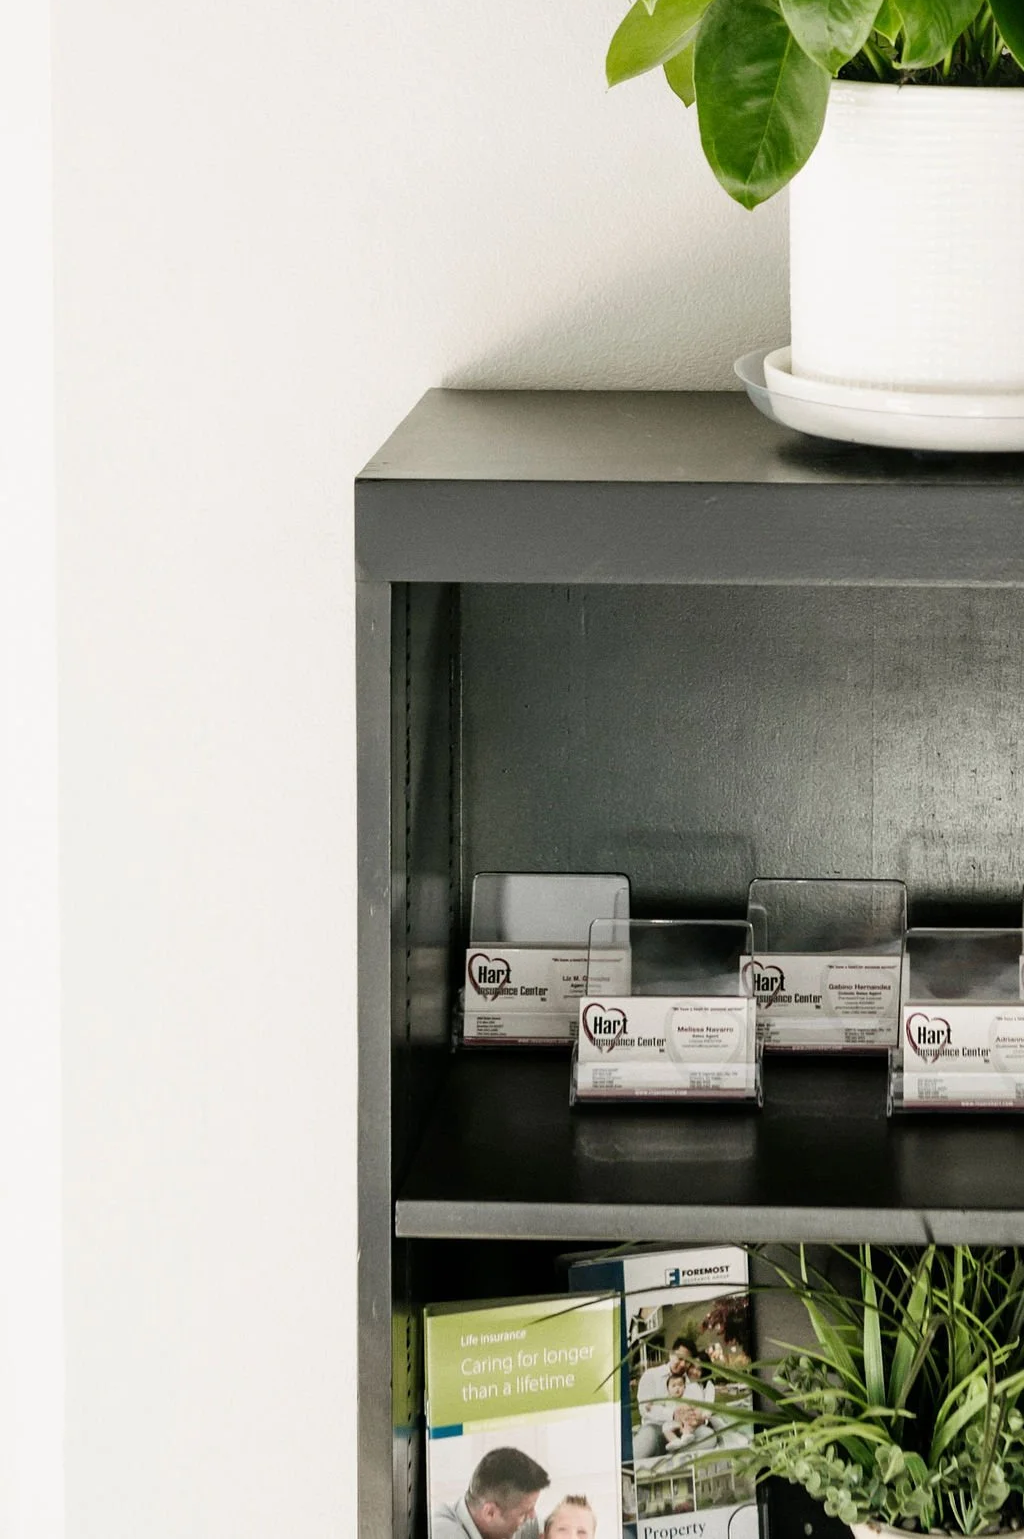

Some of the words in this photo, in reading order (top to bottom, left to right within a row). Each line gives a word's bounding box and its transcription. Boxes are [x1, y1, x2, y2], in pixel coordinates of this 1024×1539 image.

[478, 965, 512, 984] Hart
[753, 973, 786, 991] Hart
[520, 986, 548, 996] Center
[756, 993, 792, 1003] nsurance
[794, 993, 822, 1003] Center
[593, 1016, 628, 1035] Hart
[637, 1036, 667, 1047] Center
[917, 1026, 952, 1045] Hart
[962, 1047, 991, 1057] Center
[681, 1265, 730, 1277] FOREMOST
[460, 1333, 478, 1348] Life
[480, 1329, 527, 1344] insurance
[461, 1355, 513, 1375] Caring
[517, 1349, 540, 1368] for
[543, 1344, 595, 1366] longer
[462, 1382, 498, 1402] than
[503, 1382, 512, 1396] a
[516, 1373, 575, 1395] lifetime
[644, 1522, 706, 1539] Property
